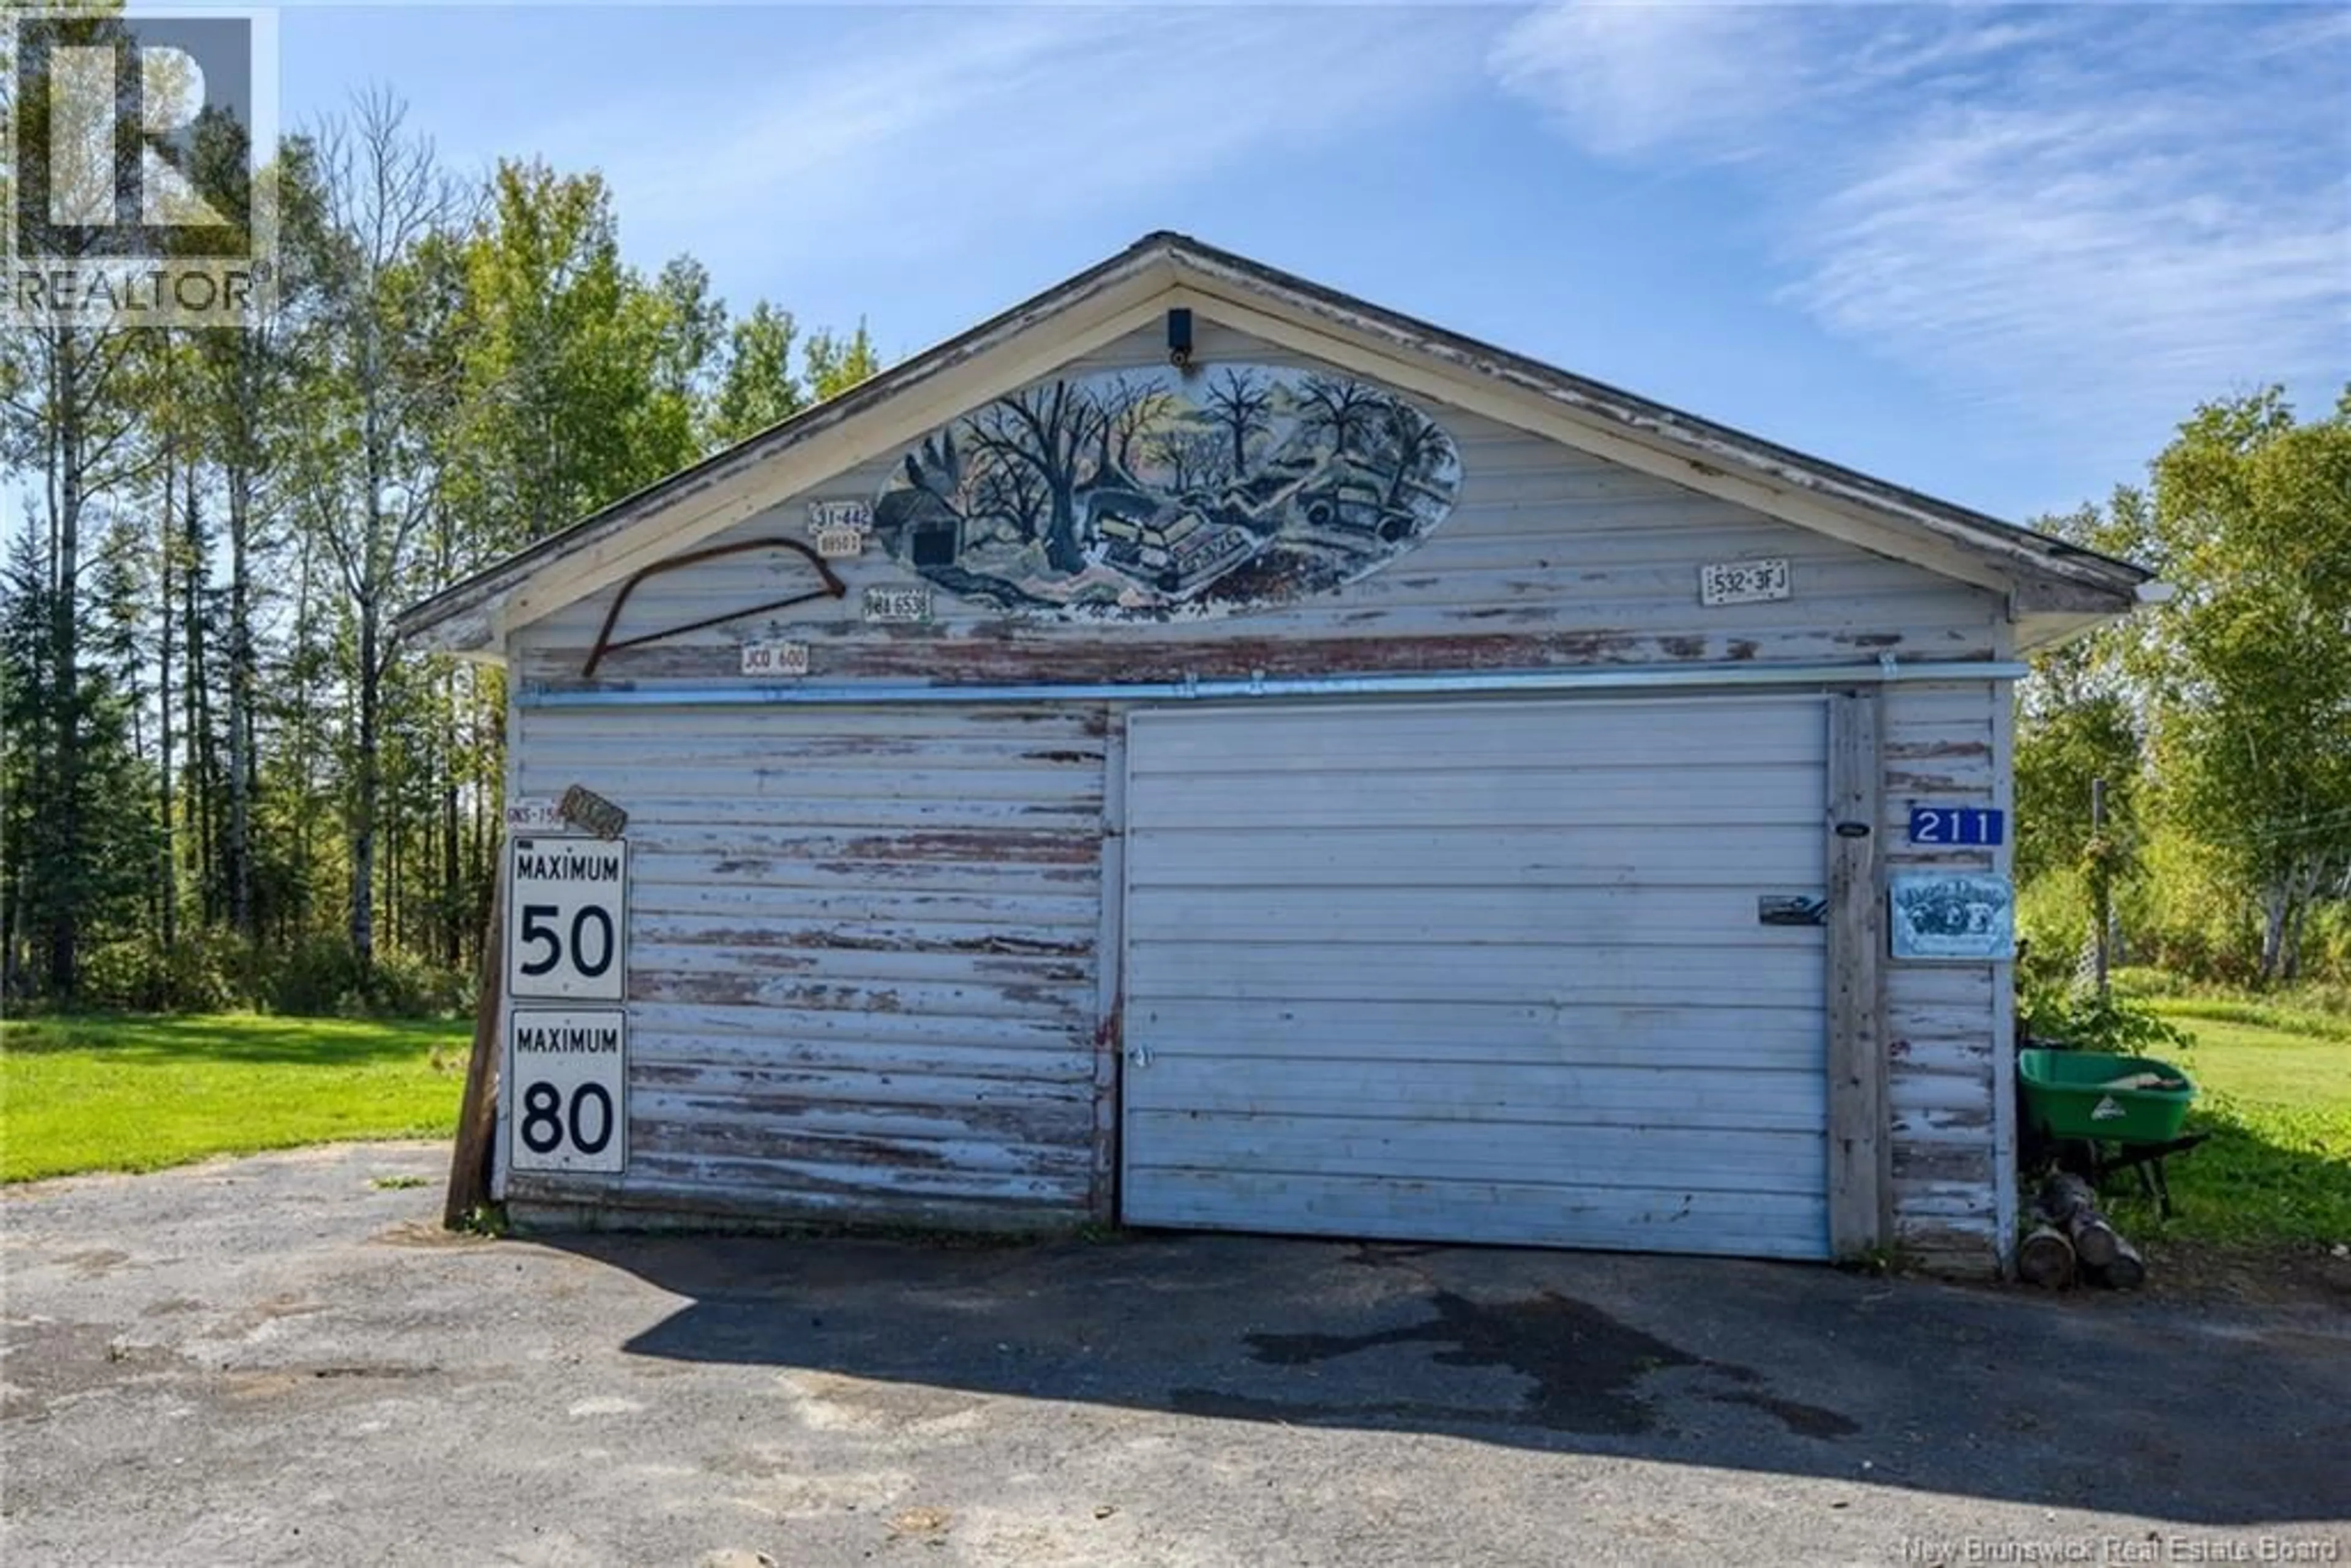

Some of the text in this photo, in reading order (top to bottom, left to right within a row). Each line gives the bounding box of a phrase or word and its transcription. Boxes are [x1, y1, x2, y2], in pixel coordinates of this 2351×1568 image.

[1916, 811, 1987, 842] 211
[517, 855, 619, 882] MAXIMUM
[520, 905, 613, 978] 50
[517, 1028, 618, 1053] MAXIMUM
[520, 1081, 613, 1155] 80
